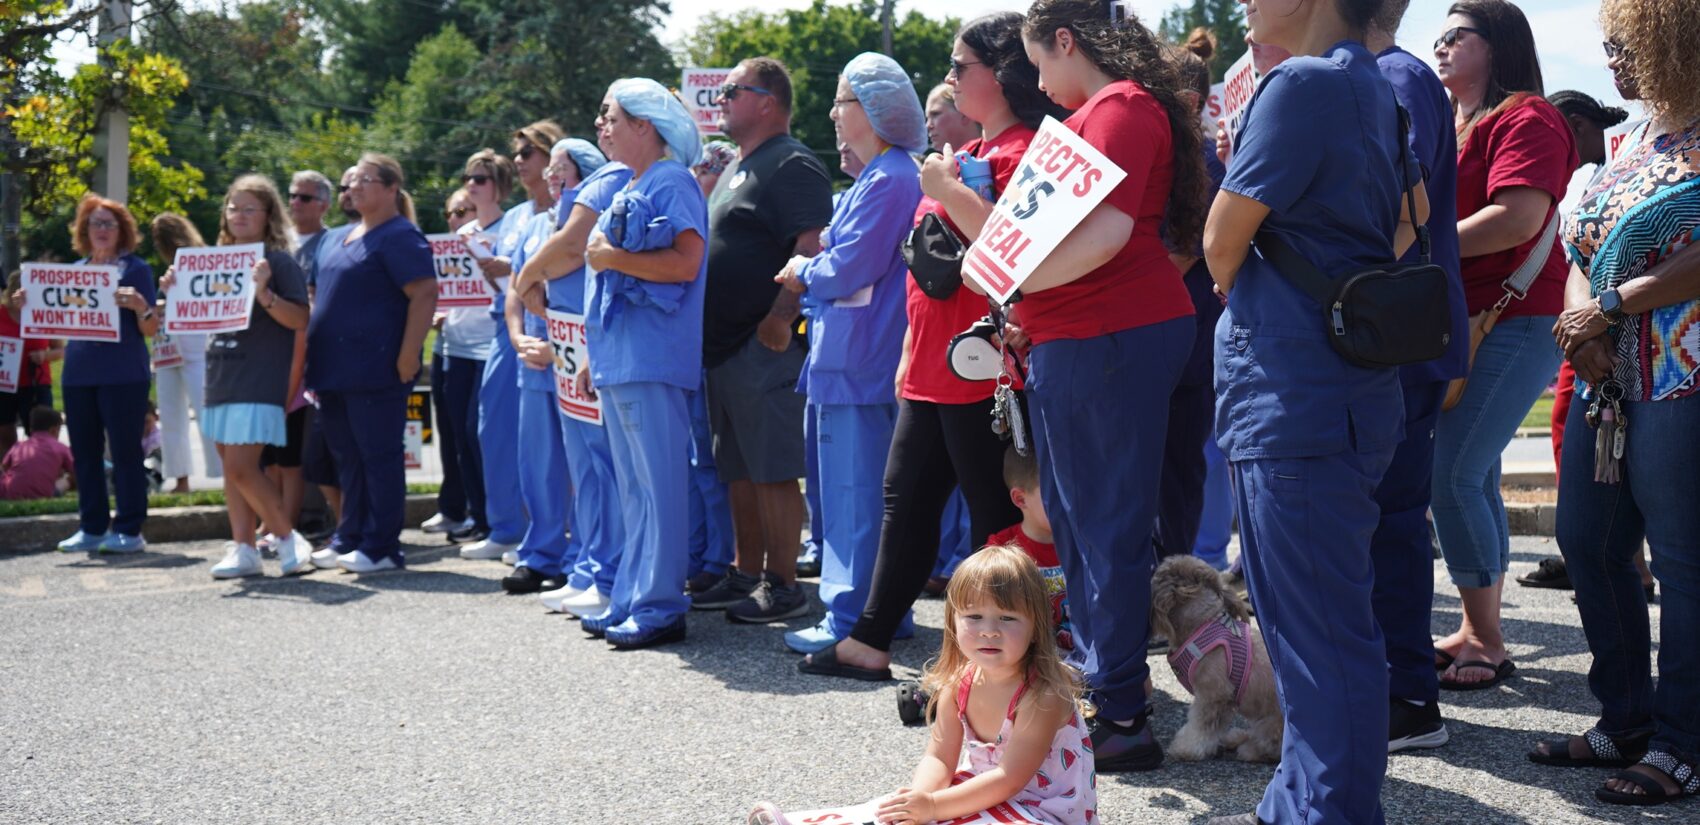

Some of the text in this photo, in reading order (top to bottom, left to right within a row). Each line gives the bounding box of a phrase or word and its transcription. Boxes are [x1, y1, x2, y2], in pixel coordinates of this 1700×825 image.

[178, 251, 256, 272] PROSPECT'S
[30, 269, 111, 287] PROSPECT'S
[190, 272, 244, 298] CUTS
[456, 280, 487, 295] HEAL
[42, 287, 100, 309] CUTS
[176, 298, 247, 318] WON'T HEAL
[32, 309, 112, 327] WON'T HEAL
